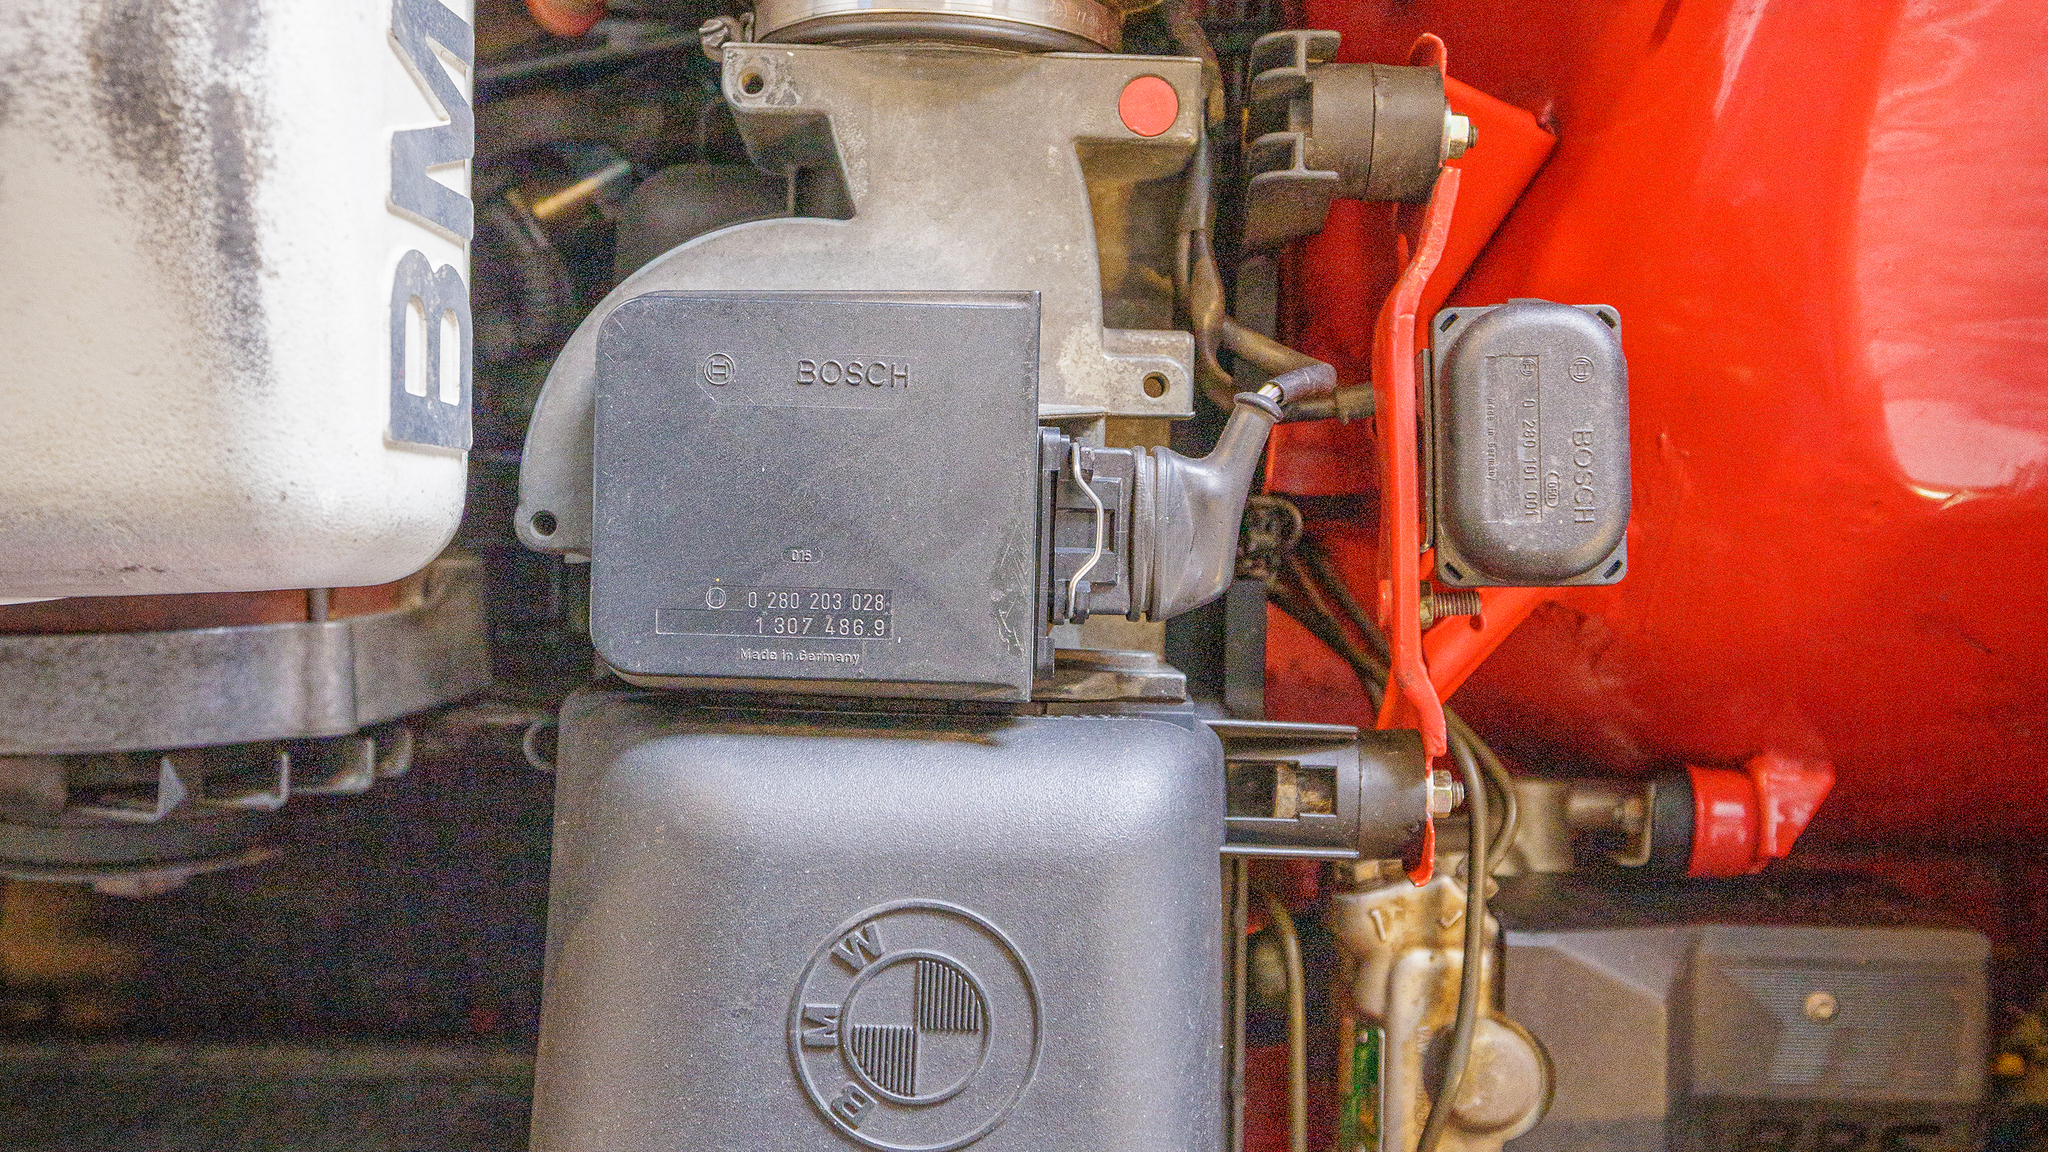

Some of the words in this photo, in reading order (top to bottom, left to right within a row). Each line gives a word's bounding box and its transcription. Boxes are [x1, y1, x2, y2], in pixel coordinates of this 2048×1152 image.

[797, 359, 910, 388] BOSCH
[1522, 399, 1536, 408] 0
[1522, 420, 1537, 448] 280
[1485, 442, 1498, 481] Germany
[1523, 458, 1538, 481] 101
[1573, 429, 1596, 523] BOSCH
[1524, 491, 1540, 516] 001
[748, 591, 757, 608] 0
[767, 592, 799, 609] 280
[809, 592, 842, 610] 203
[852, 594, 884, 611] 028
[755, 617, 763, 634] 1
[774, 617, 814, 635] 307
[824, 616, 885, 636] 486.9
[740, 648, 778, 661] Made
[781, 649, 794, 661] in
[799, 649, 860, 666] Germany
[800, 921, 885, 1130] BMW
